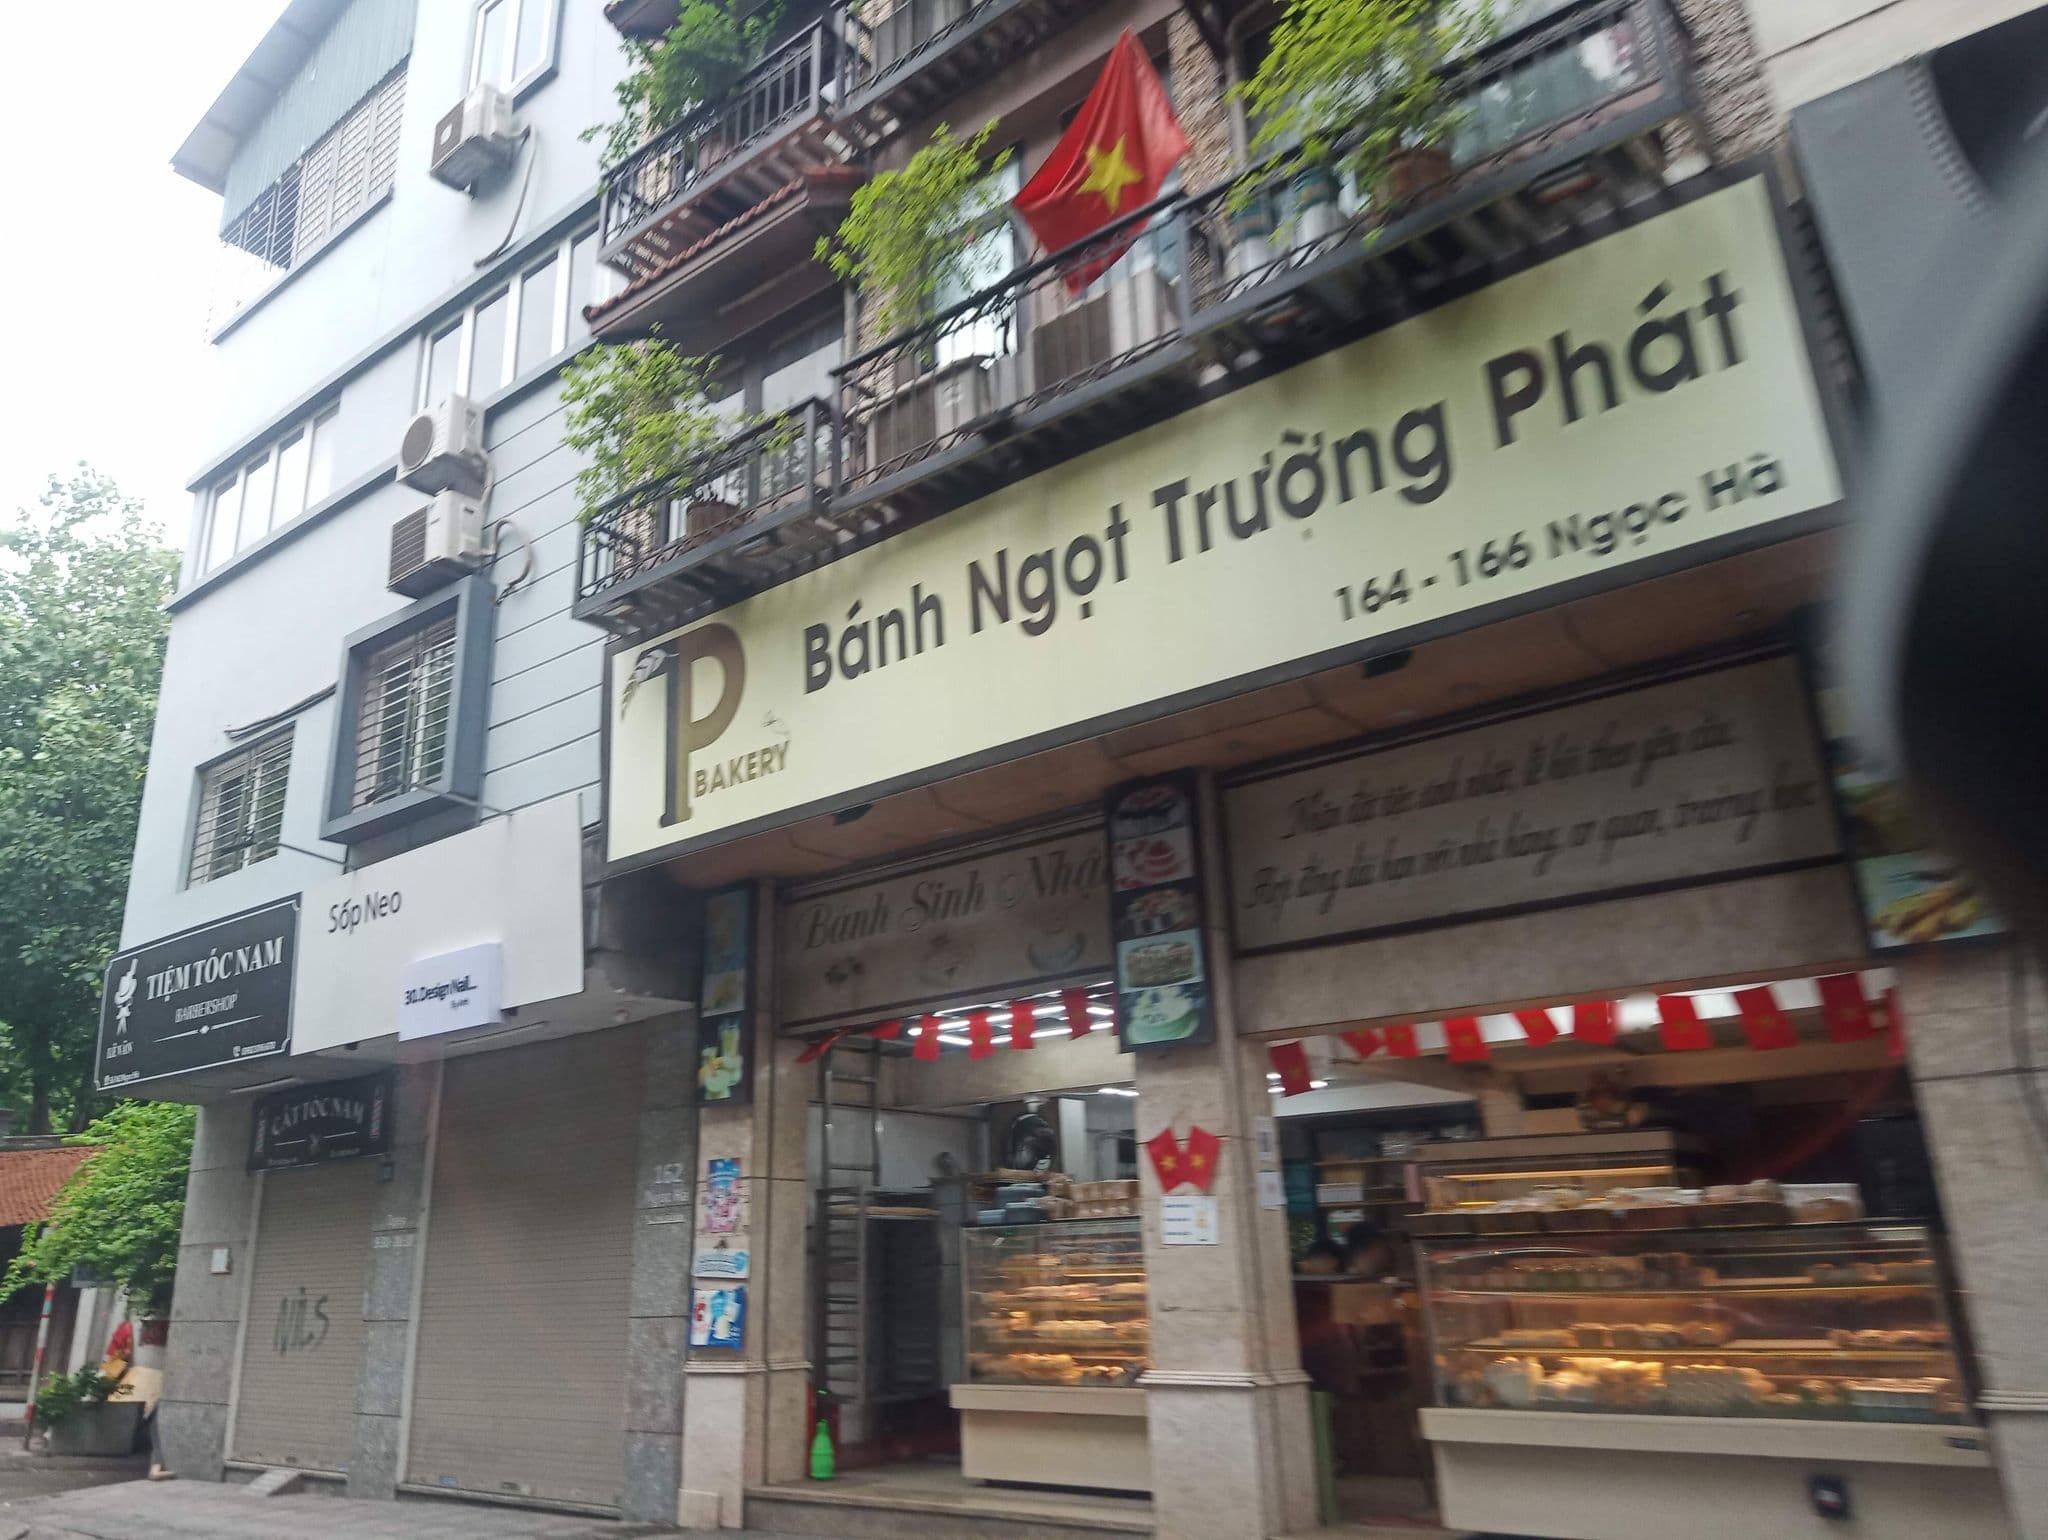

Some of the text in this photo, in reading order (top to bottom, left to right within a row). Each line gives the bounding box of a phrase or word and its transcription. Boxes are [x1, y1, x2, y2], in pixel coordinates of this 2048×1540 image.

[804, 270, 1746, 694] Bánh Ngọt Trường Phát
[1334, 569, 1413, 621] 164
[1448, 530, 1535, 587] 166
[1545, 491, 1689, 558] Ngọc
[1700, 453, 1787, 511] Hà
[696, 740, 790, 798] BAKERY
[364, 890, 402, 923] Neo
[901, 869, 985, 934] Sinh
[147, 935, 284, 1002] TIỆM TÓC NAM
